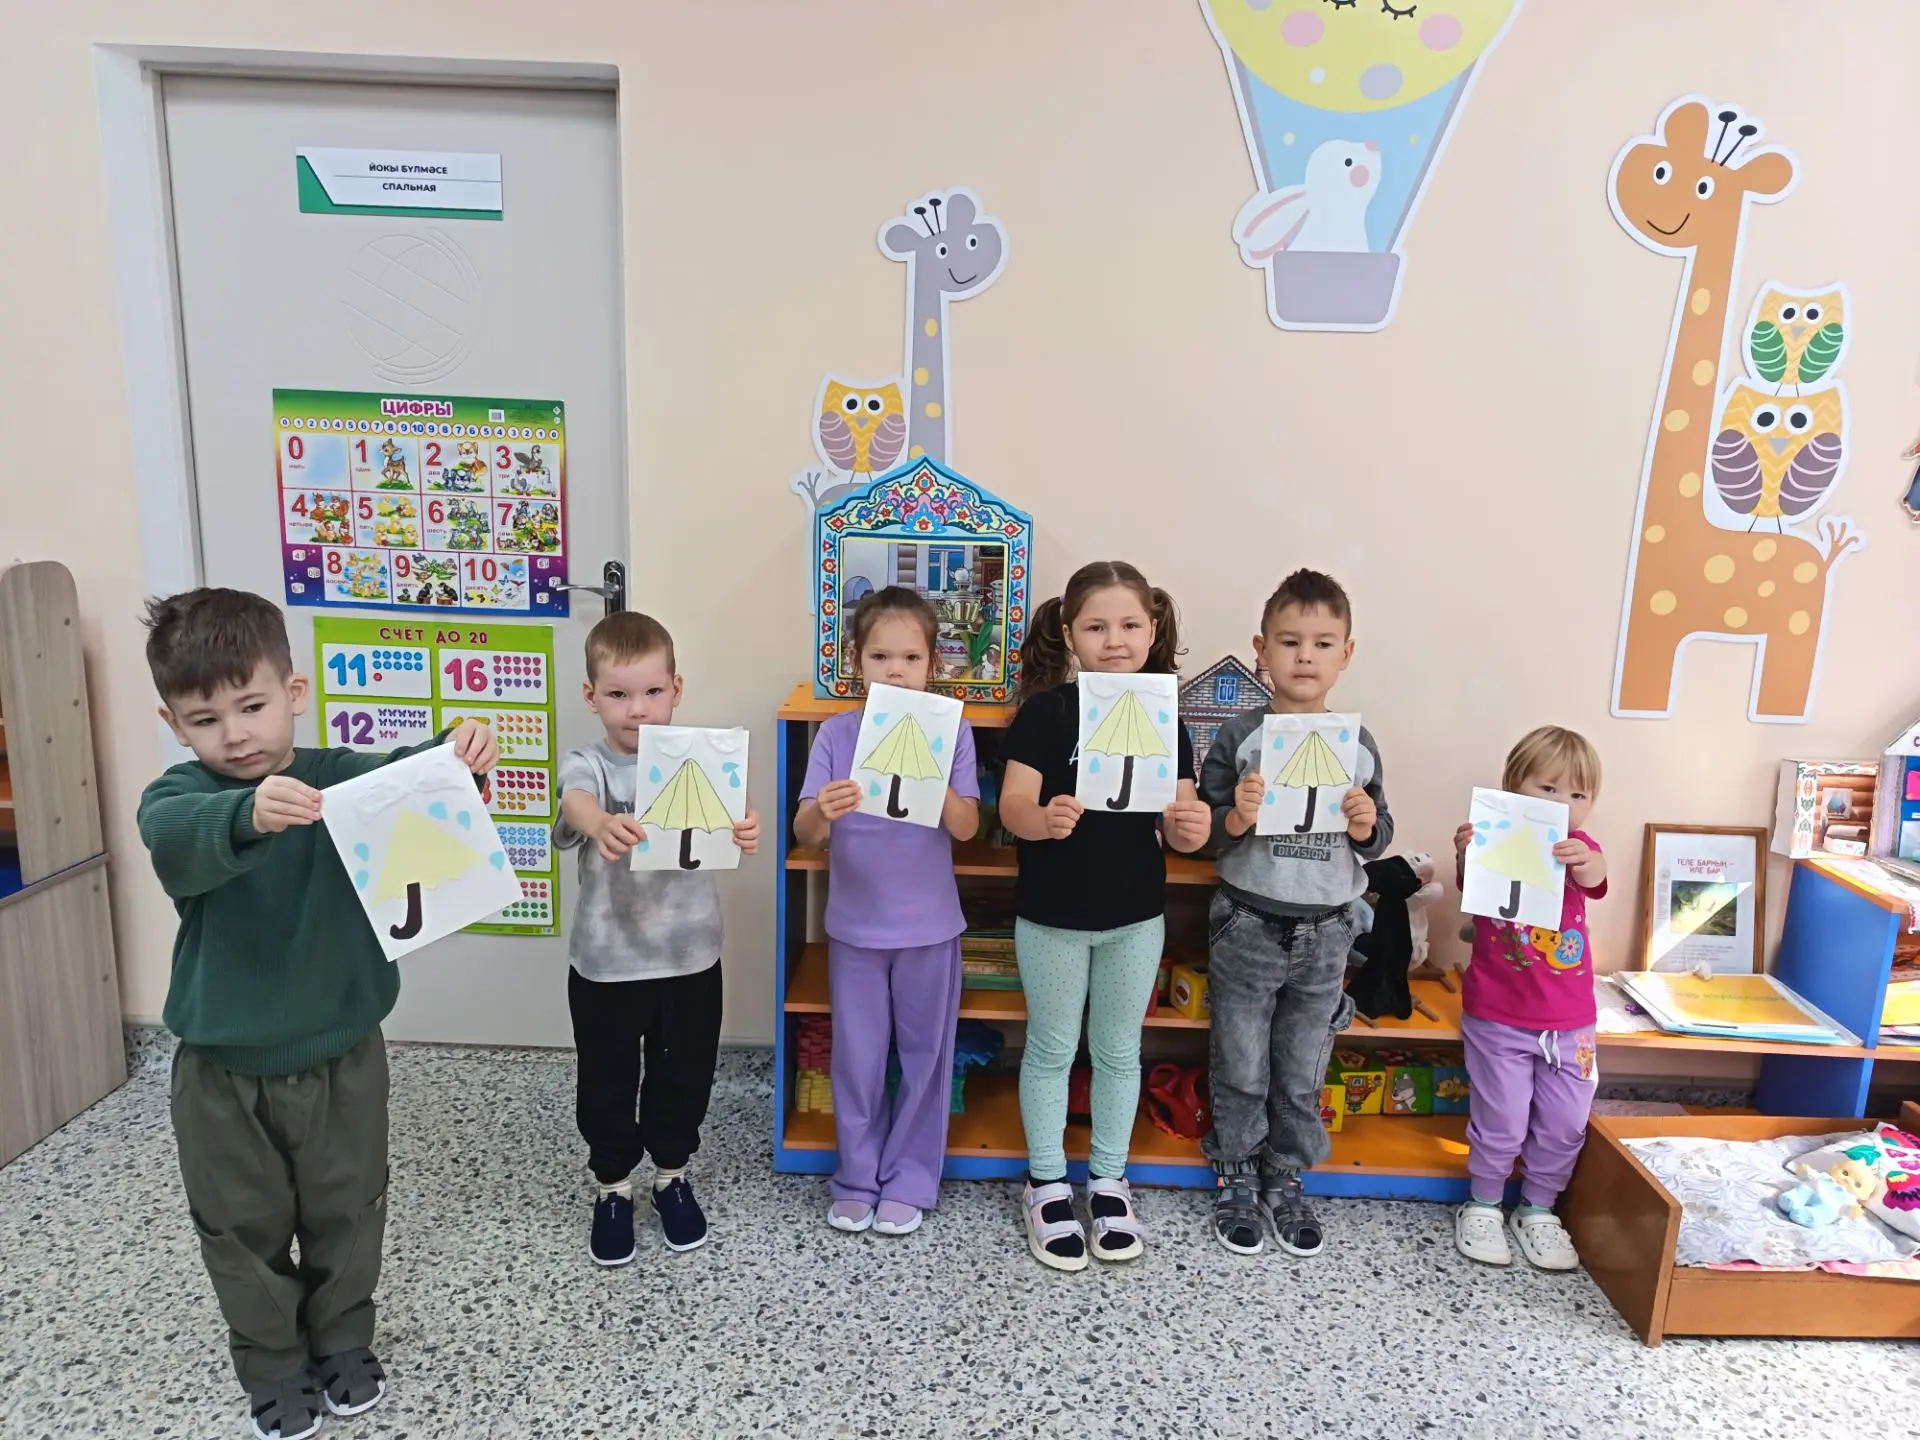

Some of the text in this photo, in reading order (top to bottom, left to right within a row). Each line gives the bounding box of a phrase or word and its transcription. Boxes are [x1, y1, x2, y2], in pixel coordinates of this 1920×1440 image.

[369, 162, 448, 175] ЙОКЫ БҮЛМӘСЕ
[382, 182, 437, 192] СПАЛЬНАЯ
[382, 400, 452, 416] ЦИФРЫ
[288, 436, 304, 460] 0
[355, 439, 367, 463] 1
[426, 442, 442, 466] 2
[496, 445, 511, 469] 3
[292, 494, 308, 517] 4
[358, 497, 373, 520] 5
[428, 500, 444, 523] 6
[497, 503, 513, 526] 7
[327, 551, 342, 574] 8
[395, 555, 410, 578] 9
[465, 558, 497, 581] 10
[379, 626, 488, 644] СЧЁТ ДО 20
[328, 652, 367, 687] 11
[444, 657, 488, 692] 16
[331, 710, 375, 745] 12
[1278, 846, 1327, 859] DIVISION
